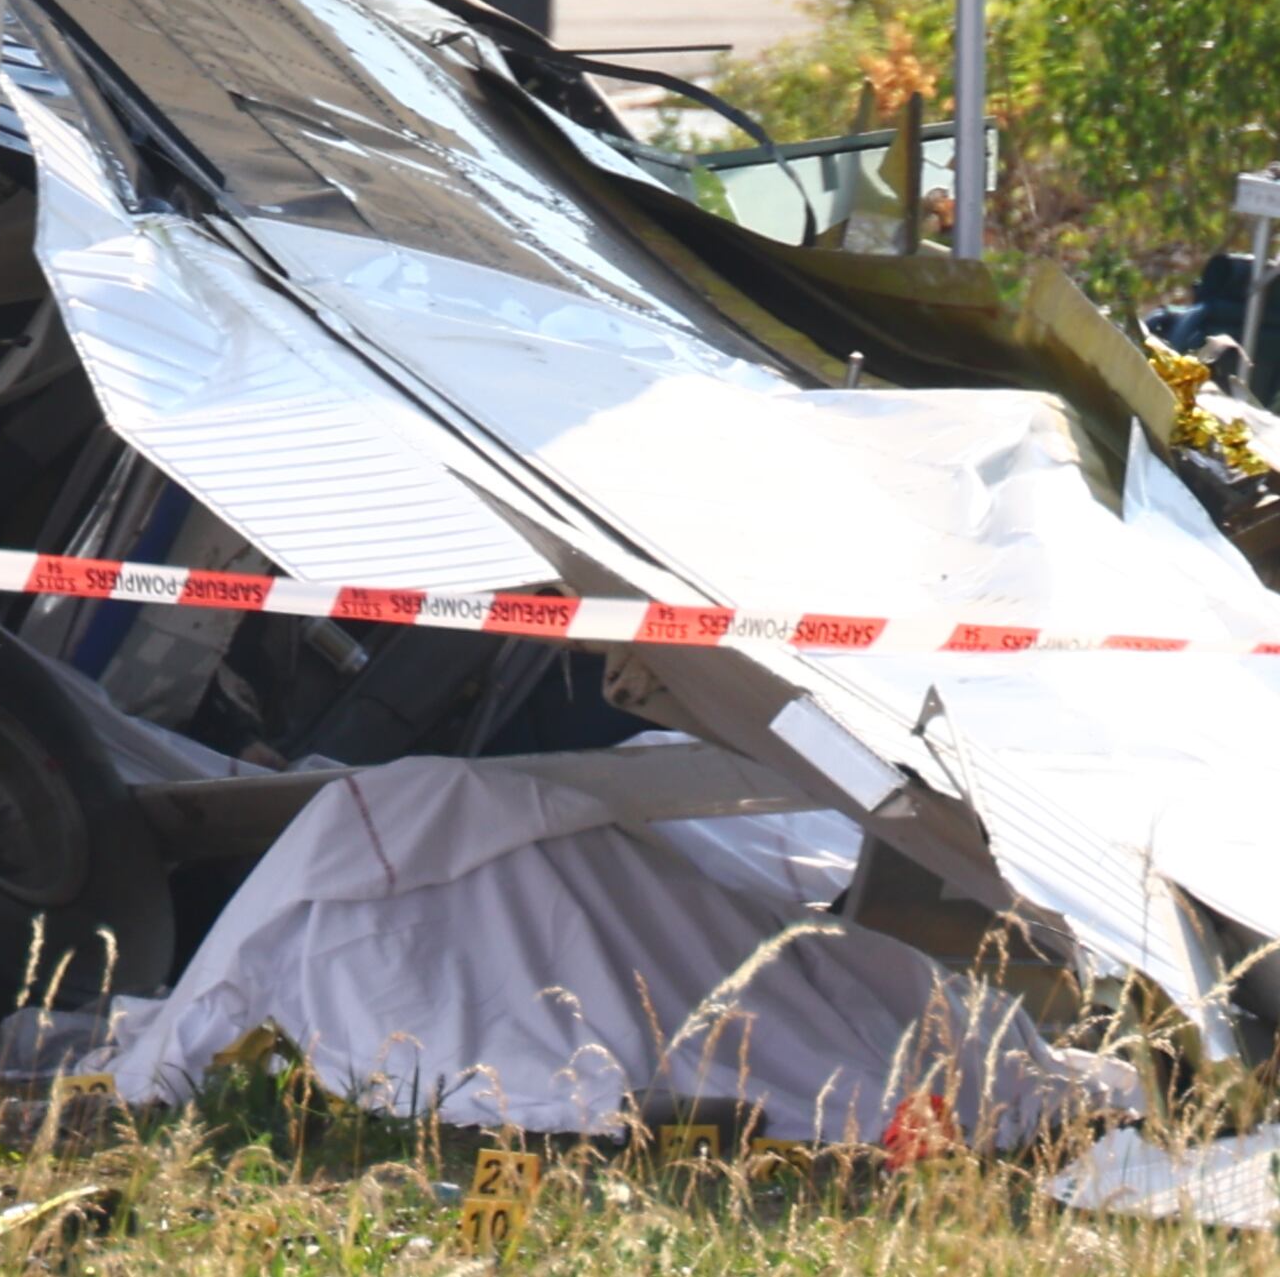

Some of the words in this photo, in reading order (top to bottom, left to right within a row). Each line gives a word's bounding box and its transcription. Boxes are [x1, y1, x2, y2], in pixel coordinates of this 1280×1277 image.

[85, 567, 263, 603] SAPEURS-POMPIERS
[390, 594, 569, 627] SAPEURS-POMPIERS
[697, 613, 875, 645] SAPEURS-POMPIERS
